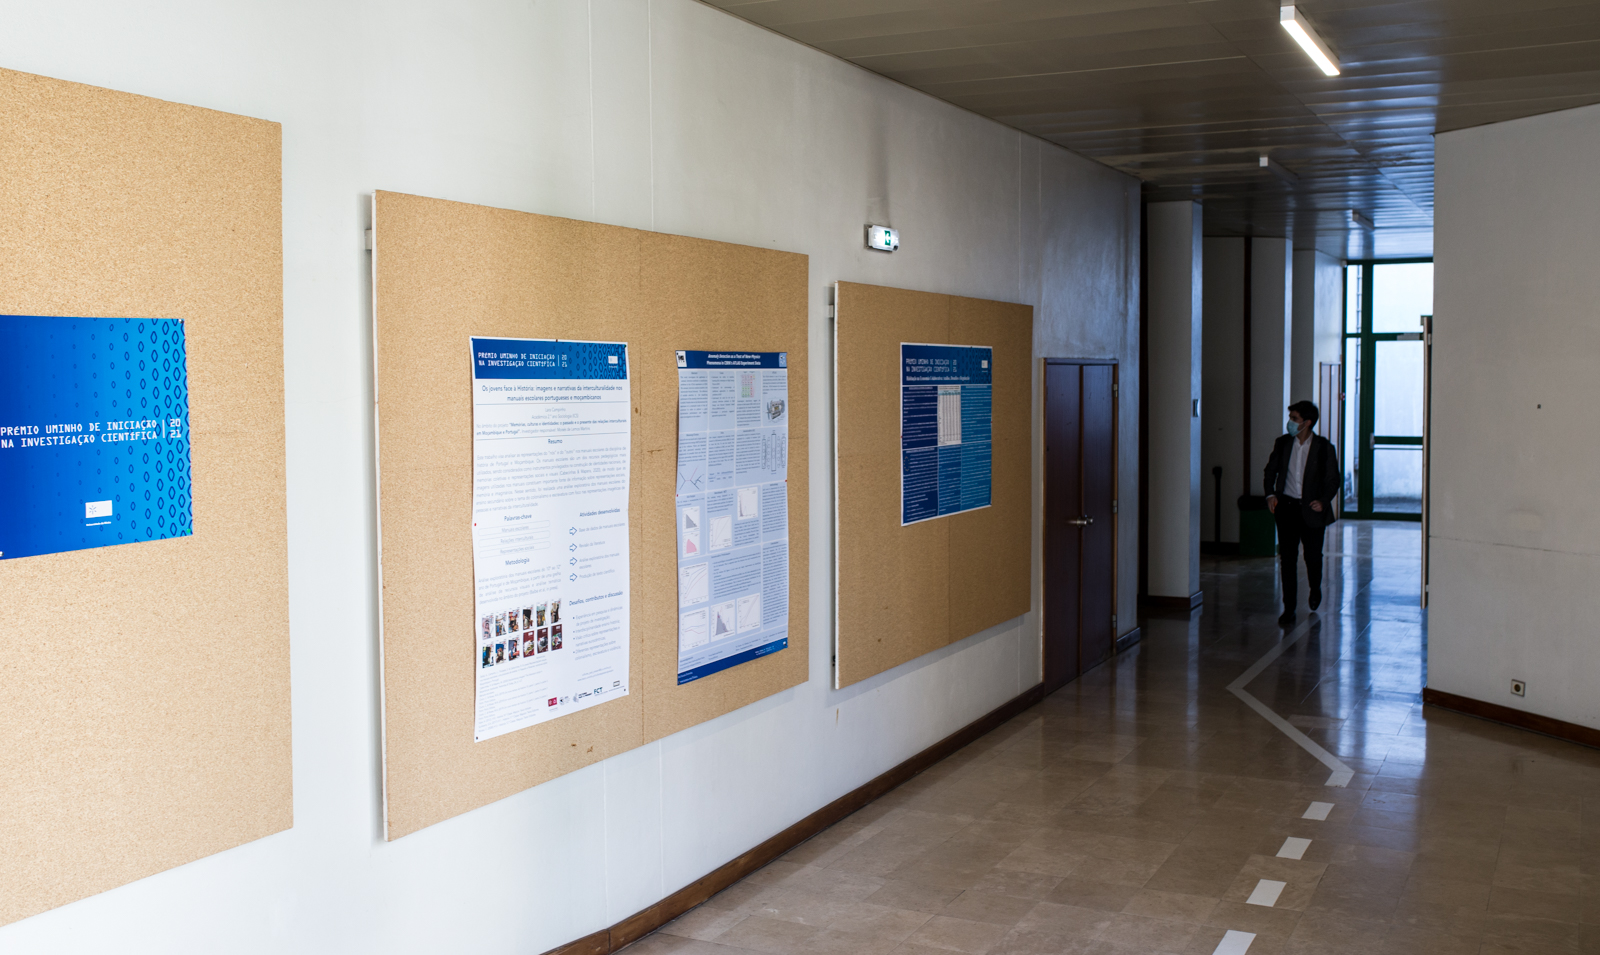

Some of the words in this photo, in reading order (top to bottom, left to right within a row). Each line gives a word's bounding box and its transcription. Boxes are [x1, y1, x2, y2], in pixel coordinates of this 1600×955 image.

[0, 425, 40, 437] PRÉMIO
[45, 423, 84, 434] UMINHO
[89, 421, 101, 432] DE
[106, 419, 158, 431] INICIAÇÃO
[169, 418, 182, 428] 20
[0, 438, 15, 449] NA
[20, 433, 96, 448] INVESTIGAÇÃO
[101, 430, 158, 443] CIENTÍFICA
[169, 429, 182, 439] 21
[505, 557, 530, 566] Metodologia
[593, 686, 603, 695] FCT
